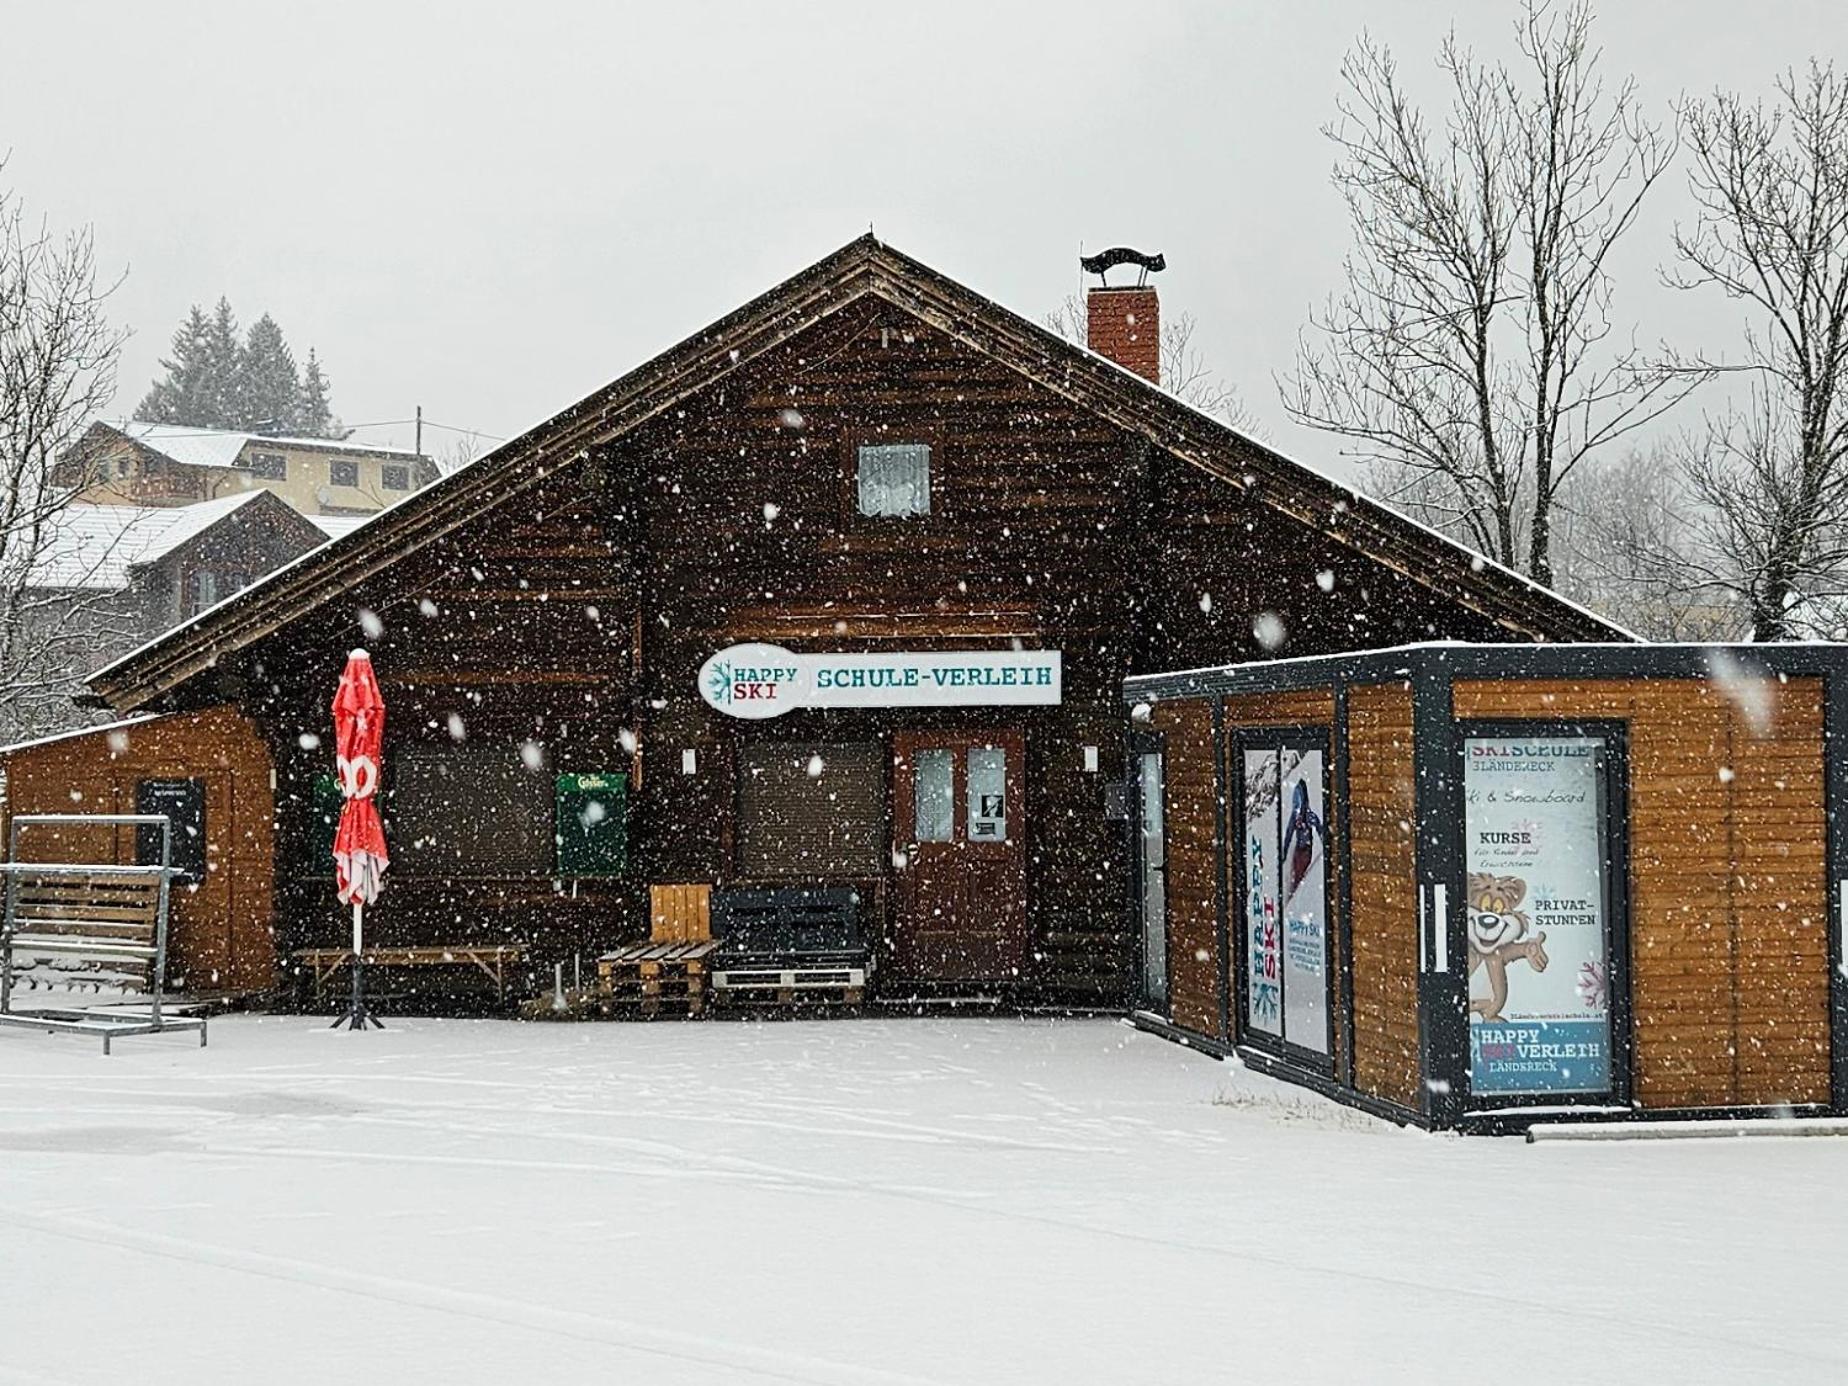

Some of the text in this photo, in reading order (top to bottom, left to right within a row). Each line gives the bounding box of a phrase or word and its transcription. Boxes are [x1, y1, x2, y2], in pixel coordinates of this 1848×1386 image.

[734, 668, 798, 682] HAPPY
[817, 667, 1053, 688] SCHULE-VERLEIH
[733, 683, 778, 700] SKI
[1480, 832, 1532, 844] KURSE
[1535, 900, 1595, 911] PRIVAT-
[1535, 914, 1596, 926] STUNDEN
[1263, 896, 1275, 979] SKI
[1481, 1030, 1539, 1044] HAPPY
